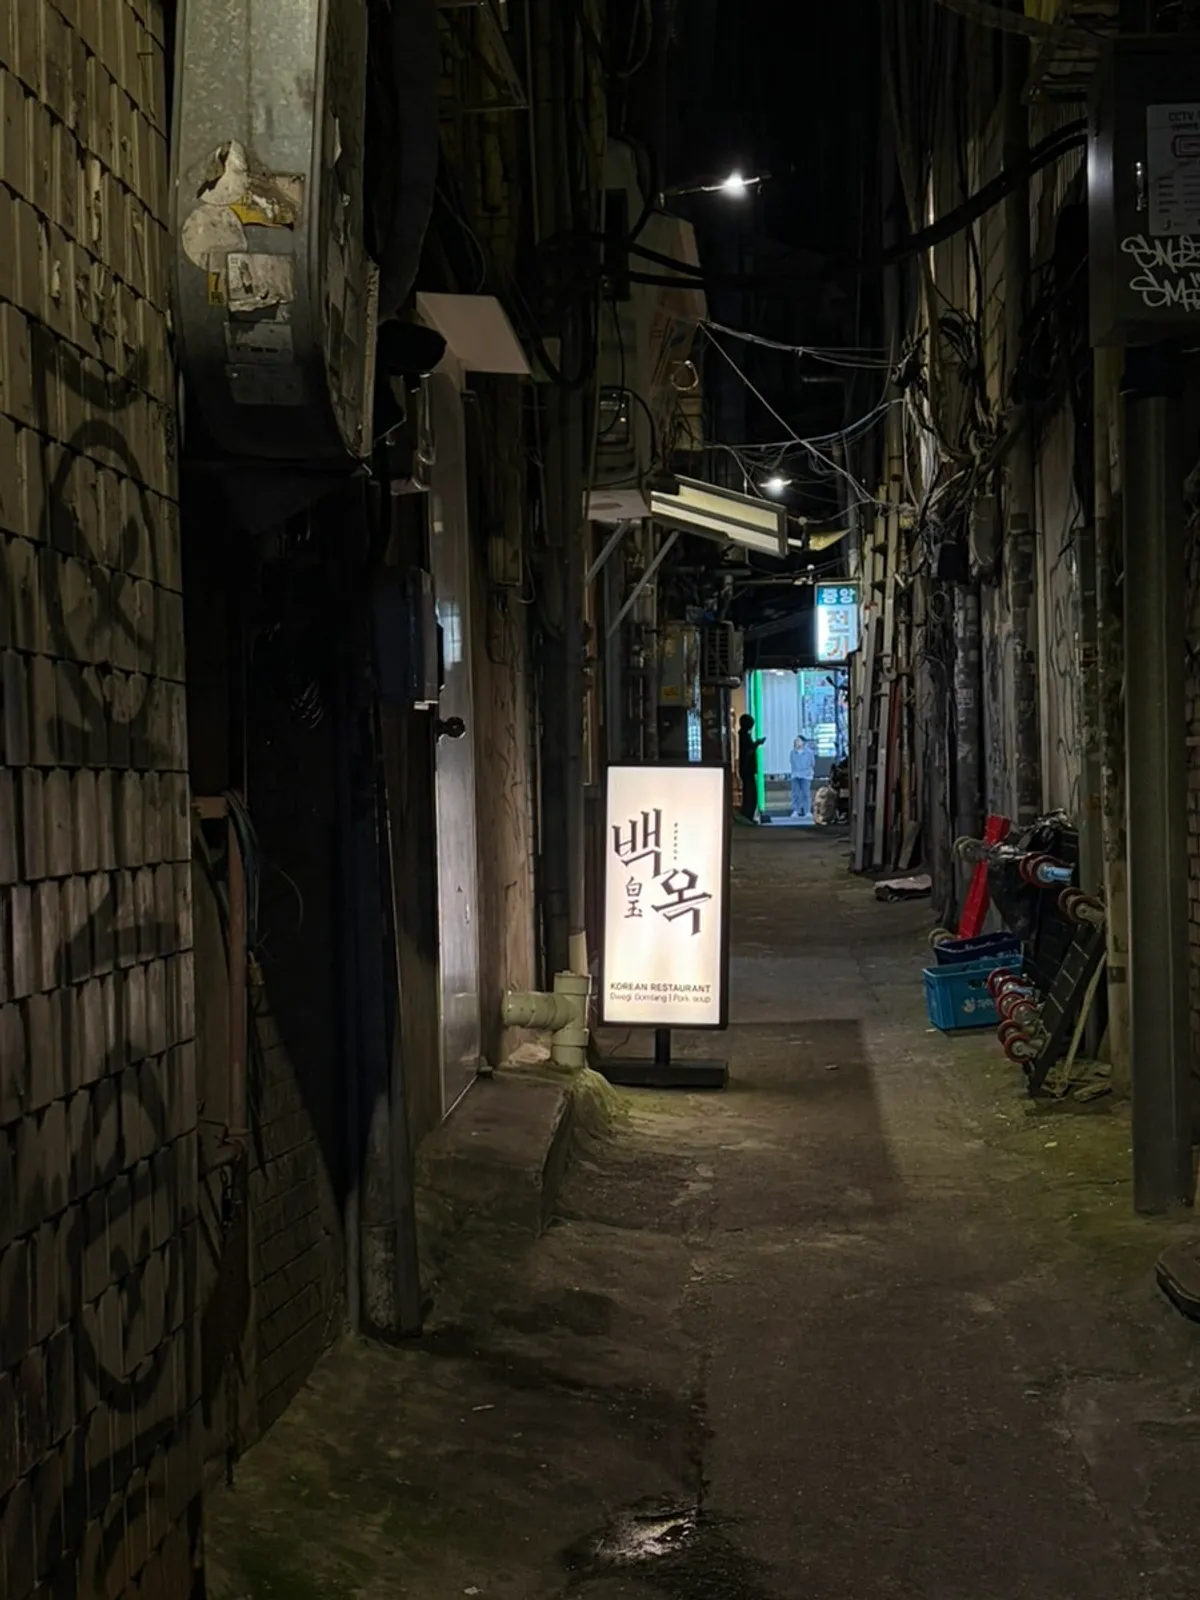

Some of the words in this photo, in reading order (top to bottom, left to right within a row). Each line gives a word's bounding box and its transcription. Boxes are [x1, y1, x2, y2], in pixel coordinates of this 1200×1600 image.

[1168, 111, 1194, 121] CCTV
[624, 876, 643, 918] 白玉
[610, 982, 648, 991] KOREAN
[650, 983, 711, 993] RESTAURANT
